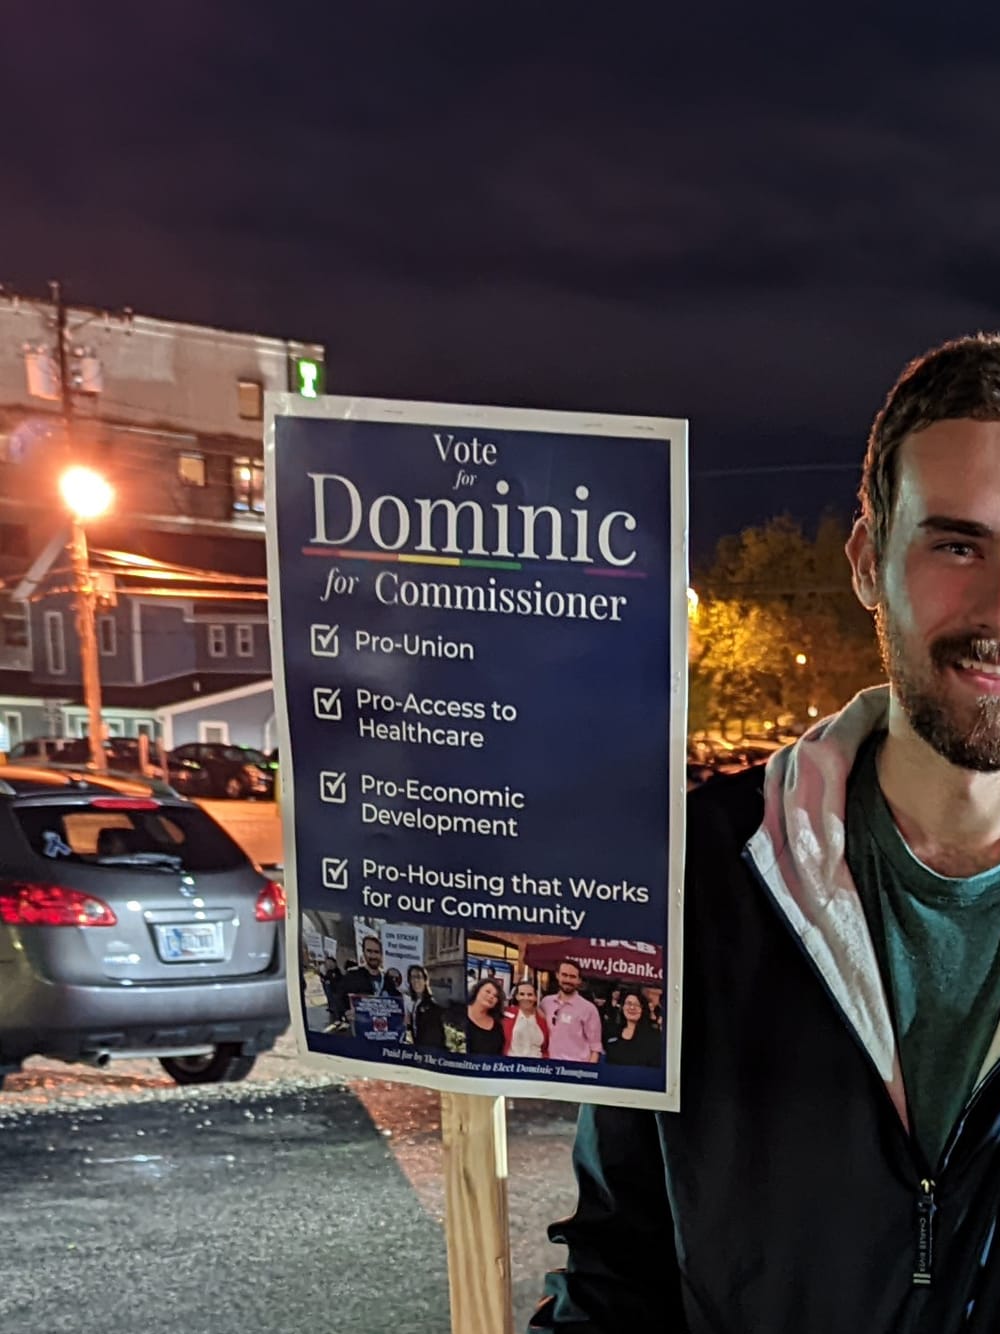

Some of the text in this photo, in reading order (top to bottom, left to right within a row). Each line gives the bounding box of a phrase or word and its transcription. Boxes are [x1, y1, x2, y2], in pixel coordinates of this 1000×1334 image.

[434, 433, 497, 465] Vote
[453, 469, 477, 489] for
[307, 472, 637, 566] Dominic
[320, 567, 627, 621] for Commissioner
[355, 631, 474, 660] Pro-Union
[356, 689, 517, 721] Pro-Access to
[359, 719, 484, 748] Healthcare
[361, 775, 525, 809] Pro-Economic
[361, 803, 518, 837] Development
[362, 860, 649, 903] Pro-Housing that Works
[361, 886, 586, 929] for our Community
[482, 1063, 491, 1071] to
[493, 1062, 514, 1073] Elect
